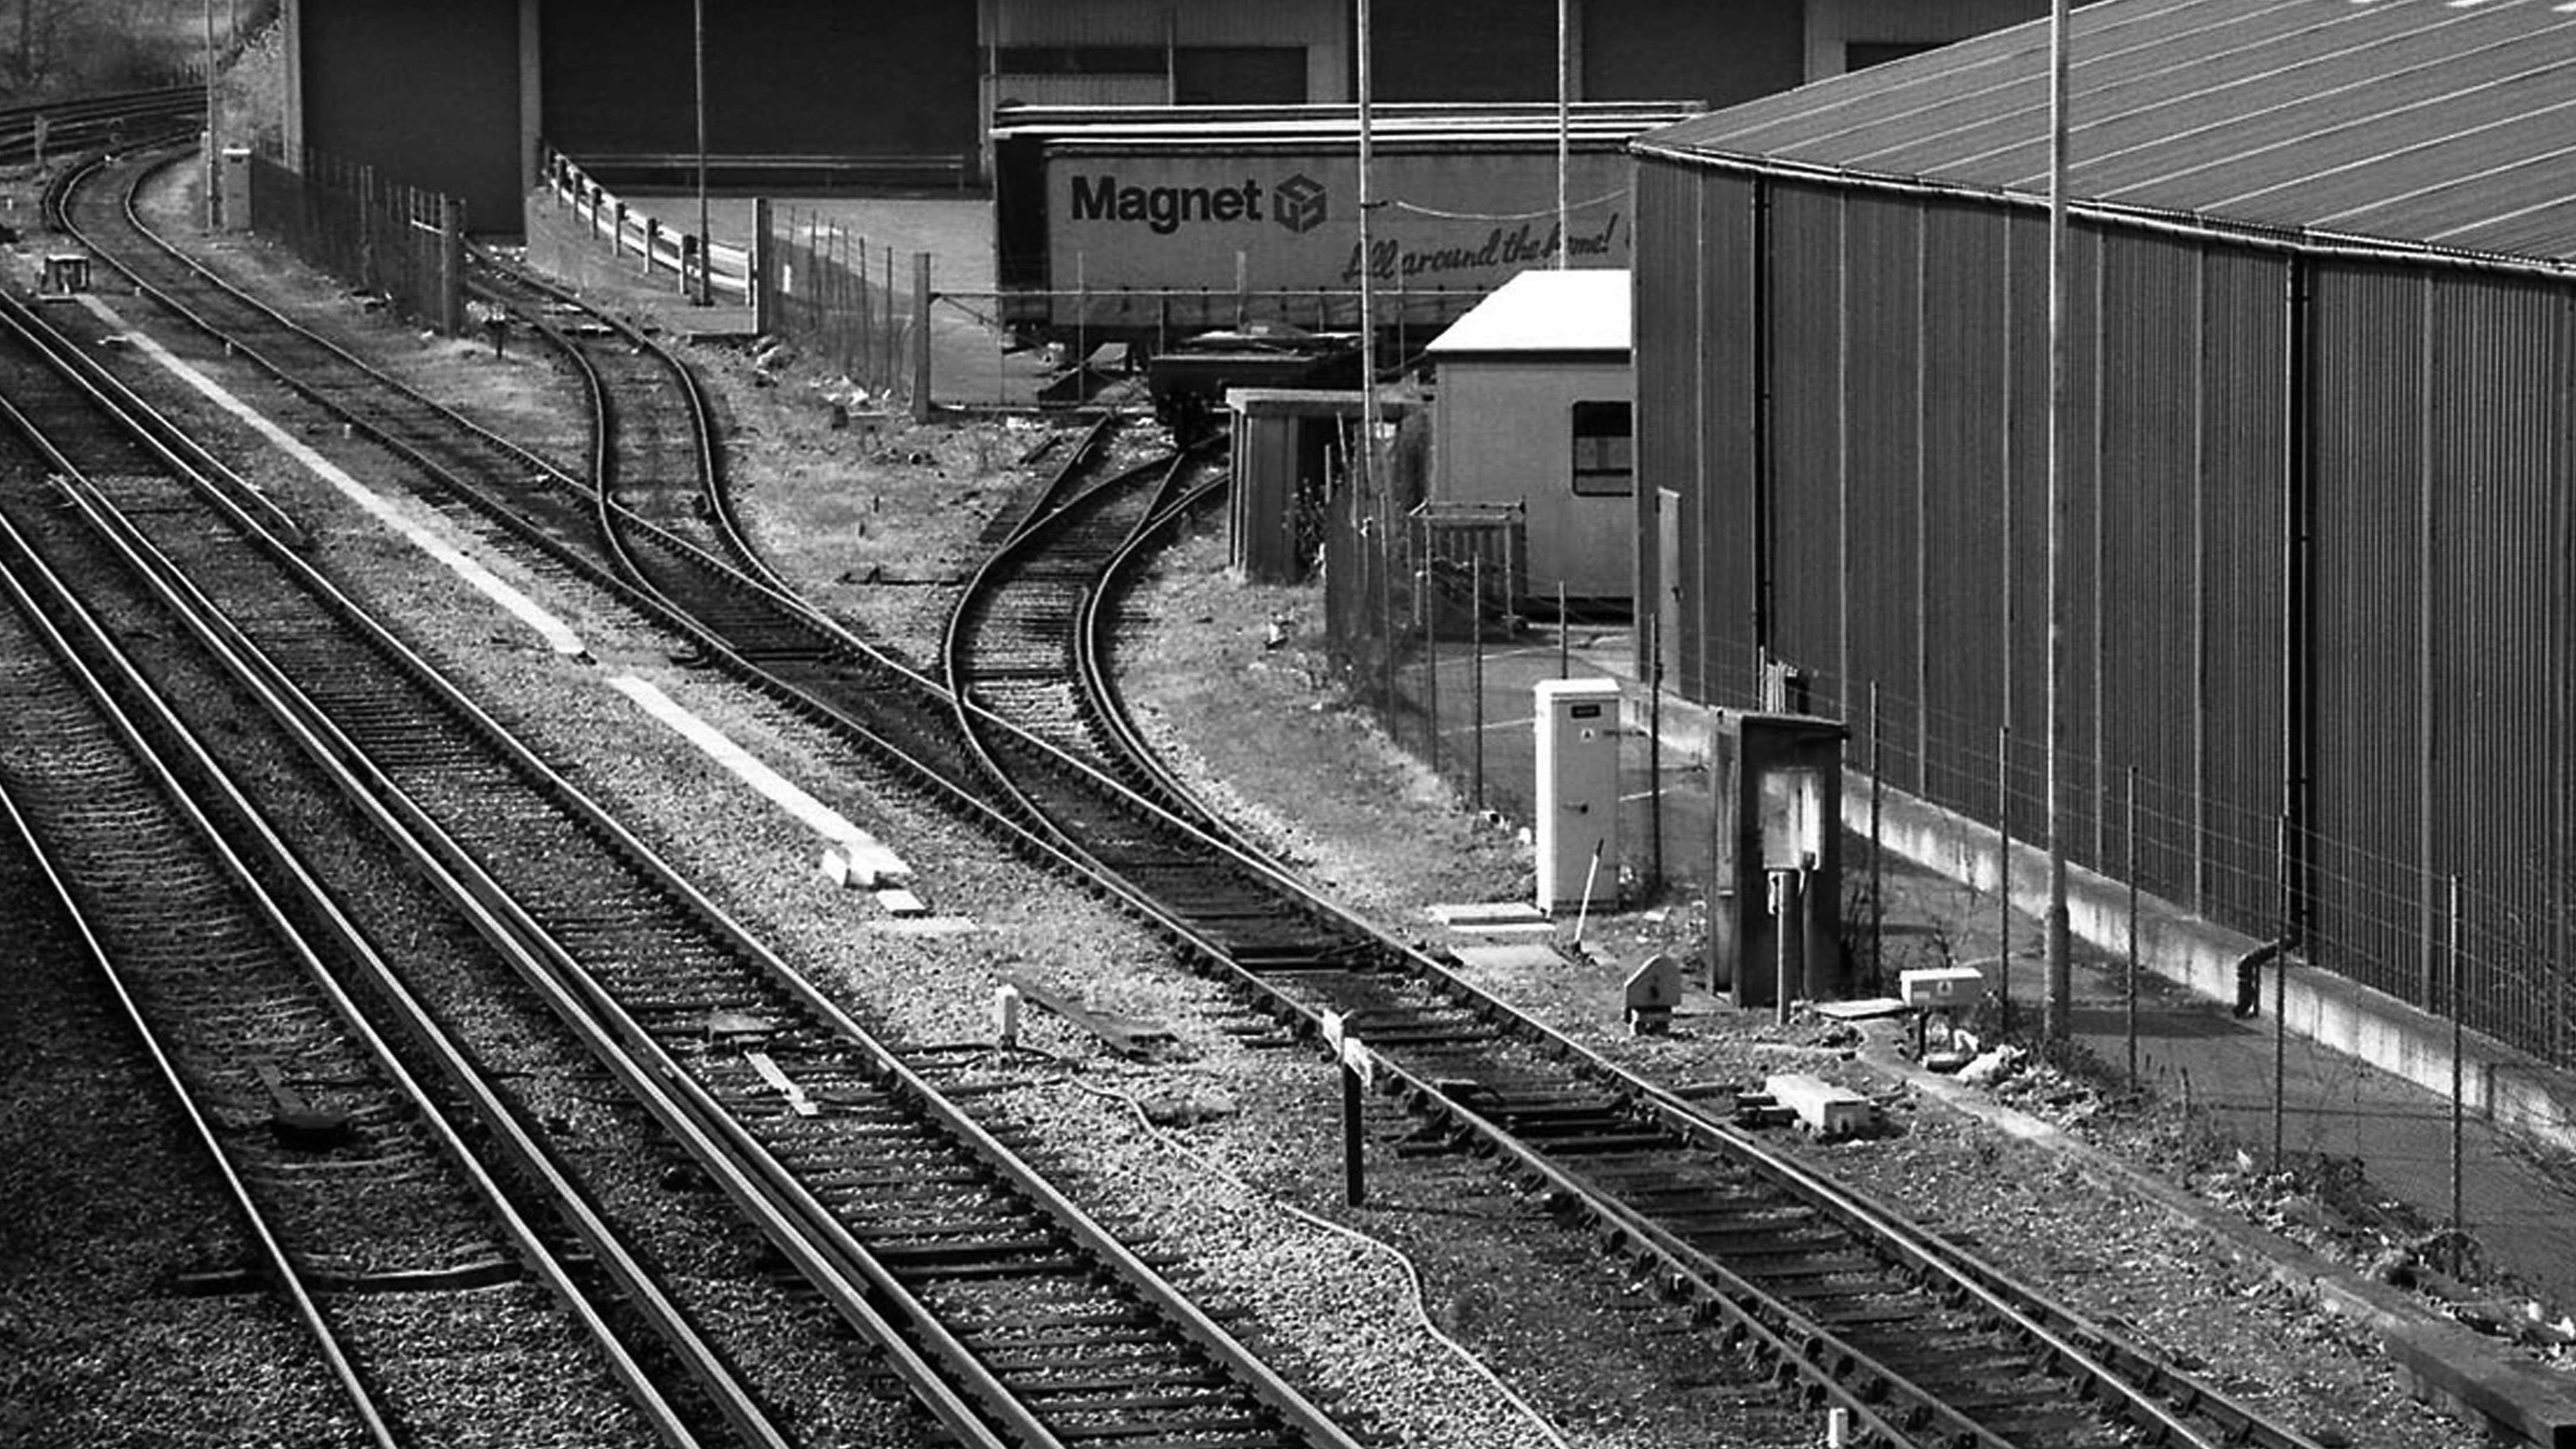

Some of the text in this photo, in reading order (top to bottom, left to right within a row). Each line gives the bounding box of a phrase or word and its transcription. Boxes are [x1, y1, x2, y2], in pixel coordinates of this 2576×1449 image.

[1071, 176, 1262, 234] Magnet
[1342, 239, 1398, 282] All
[1402, 228, 1502, 272] around
[1503, 224, 1541, 263] the
